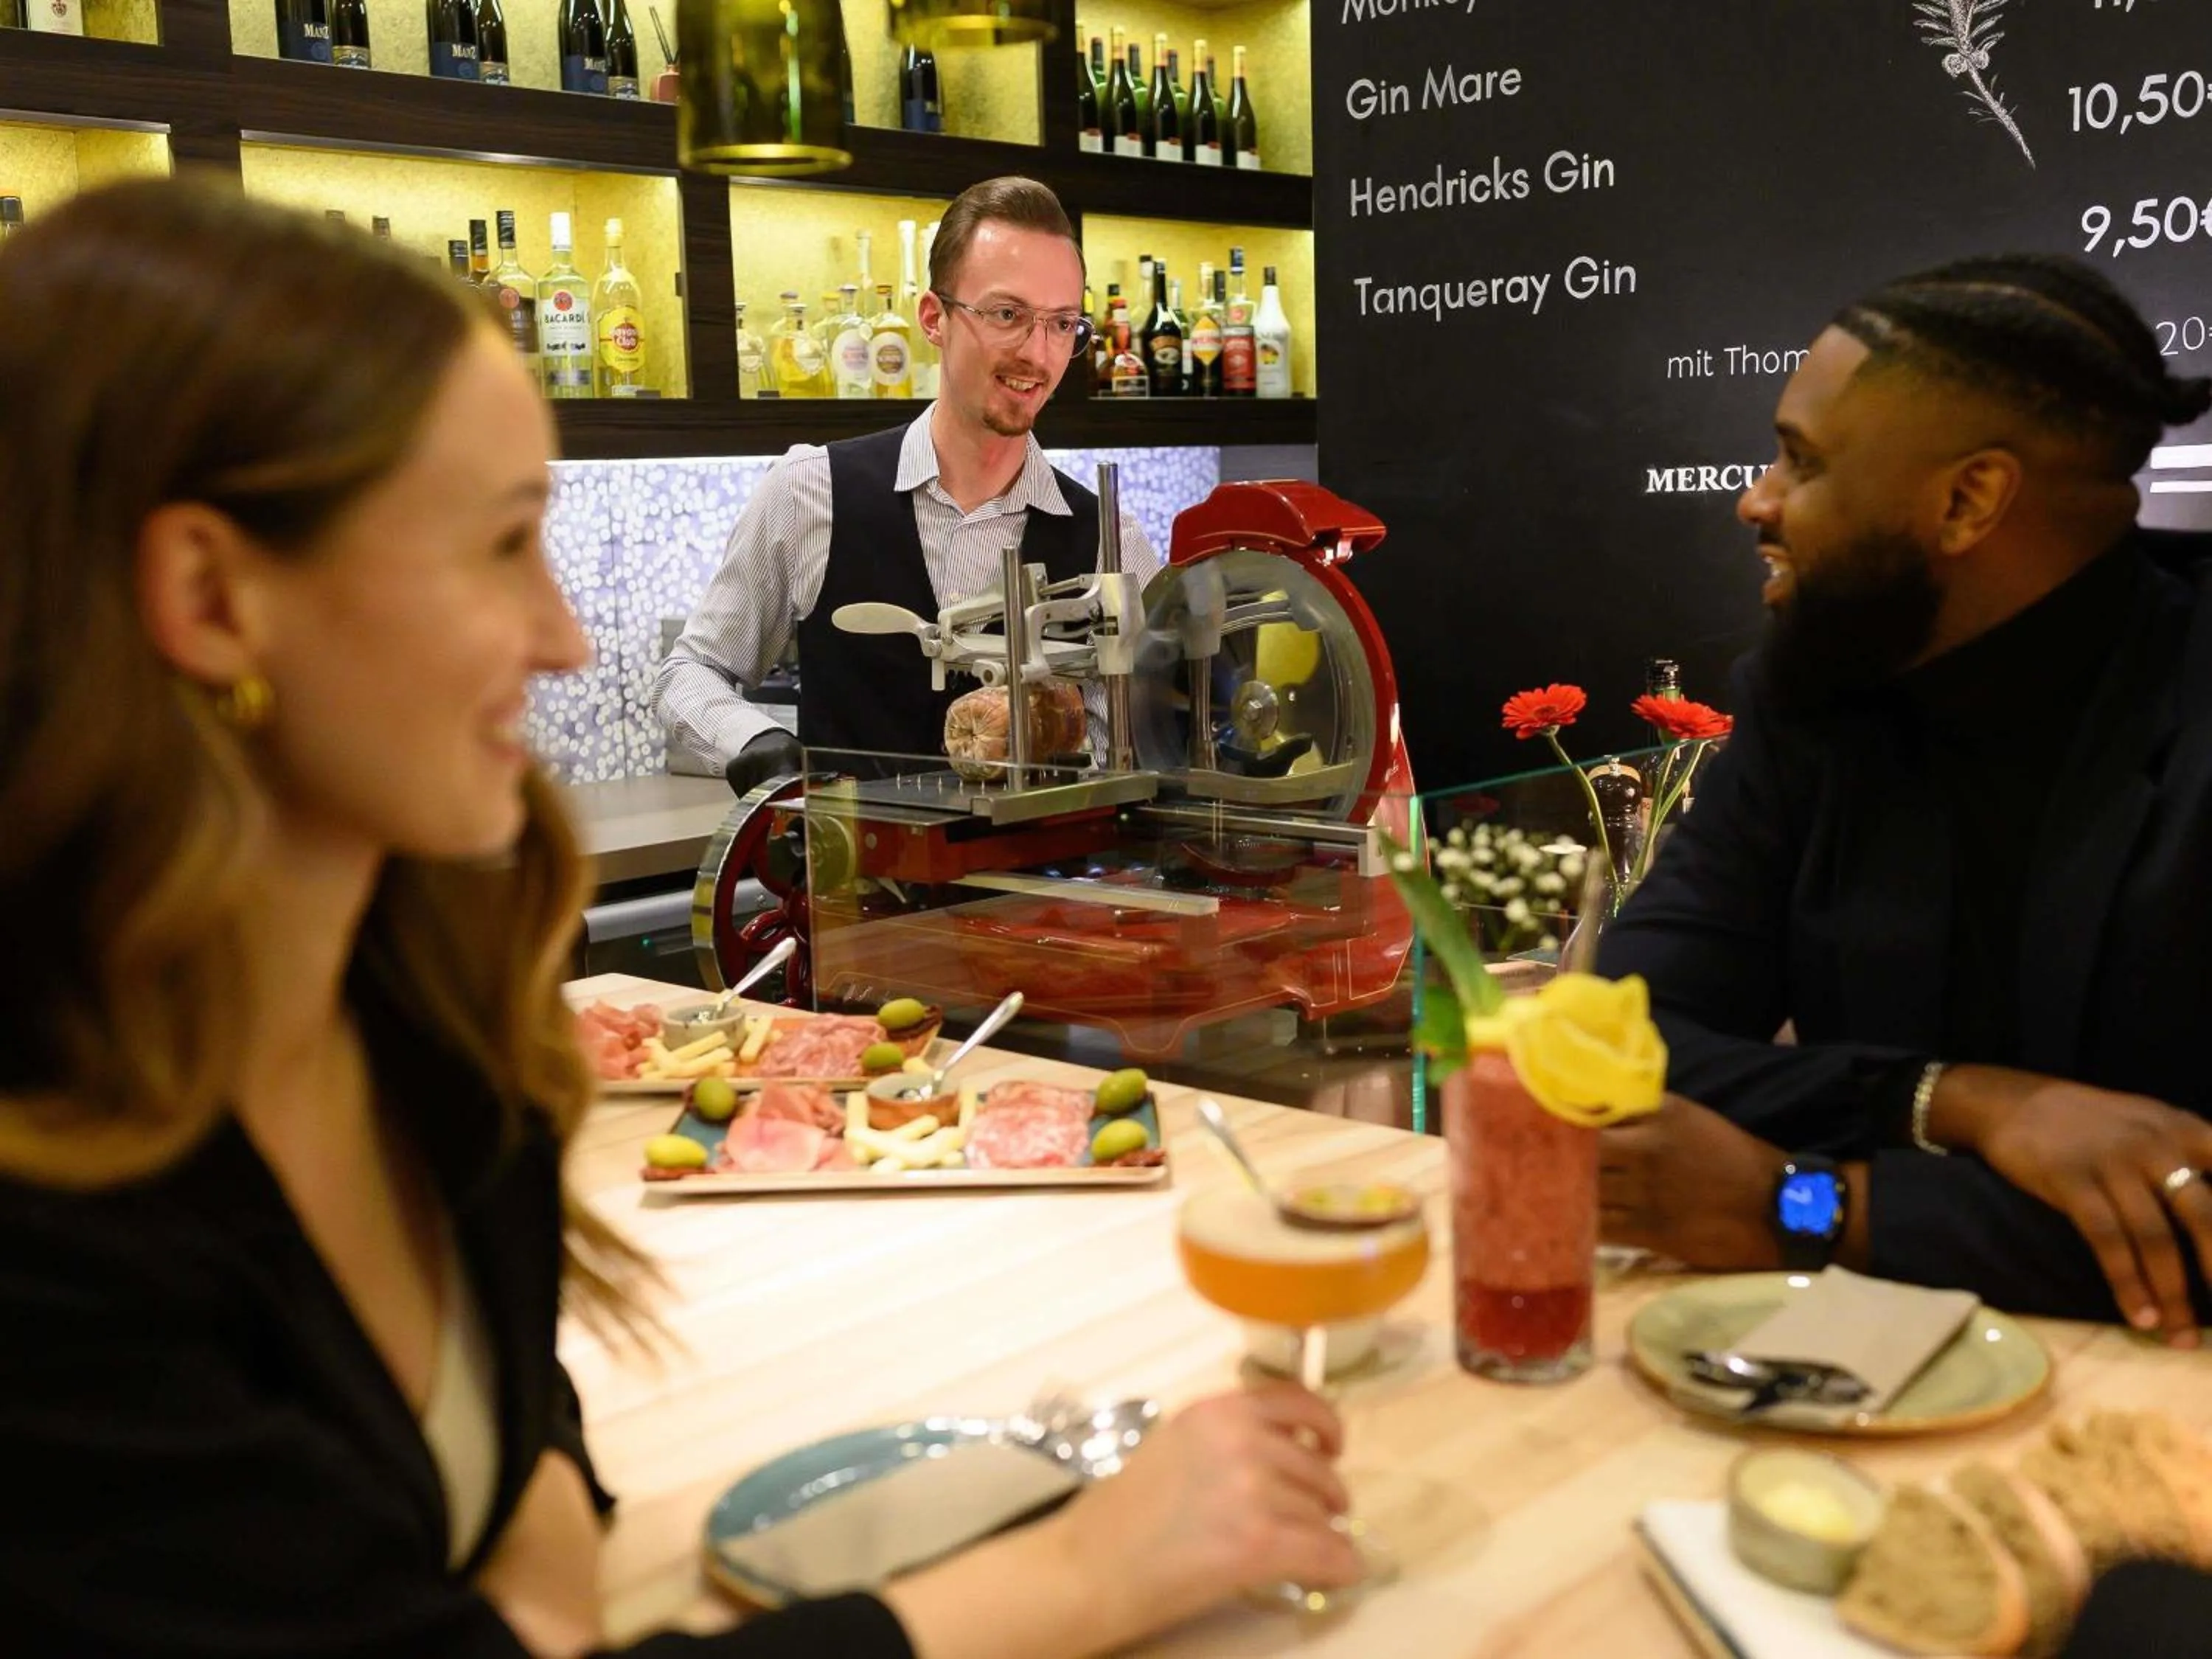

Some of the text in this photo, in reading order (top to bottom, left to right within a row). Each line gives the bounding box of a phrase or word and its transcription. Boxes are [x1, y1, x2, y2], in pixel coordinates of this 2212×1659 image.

[1346, 65, 1522, 119] Gin Mare
[2068, 71, 2212, 135] 10,50
[1350, 150, 1615, 218] Hendricks Gin
[1354, 256, 1636, 322] Tanqueray Gin
[1667, 344, 1810, 378] mit Thom
[1645, 464, 1774, 493] MERCU
